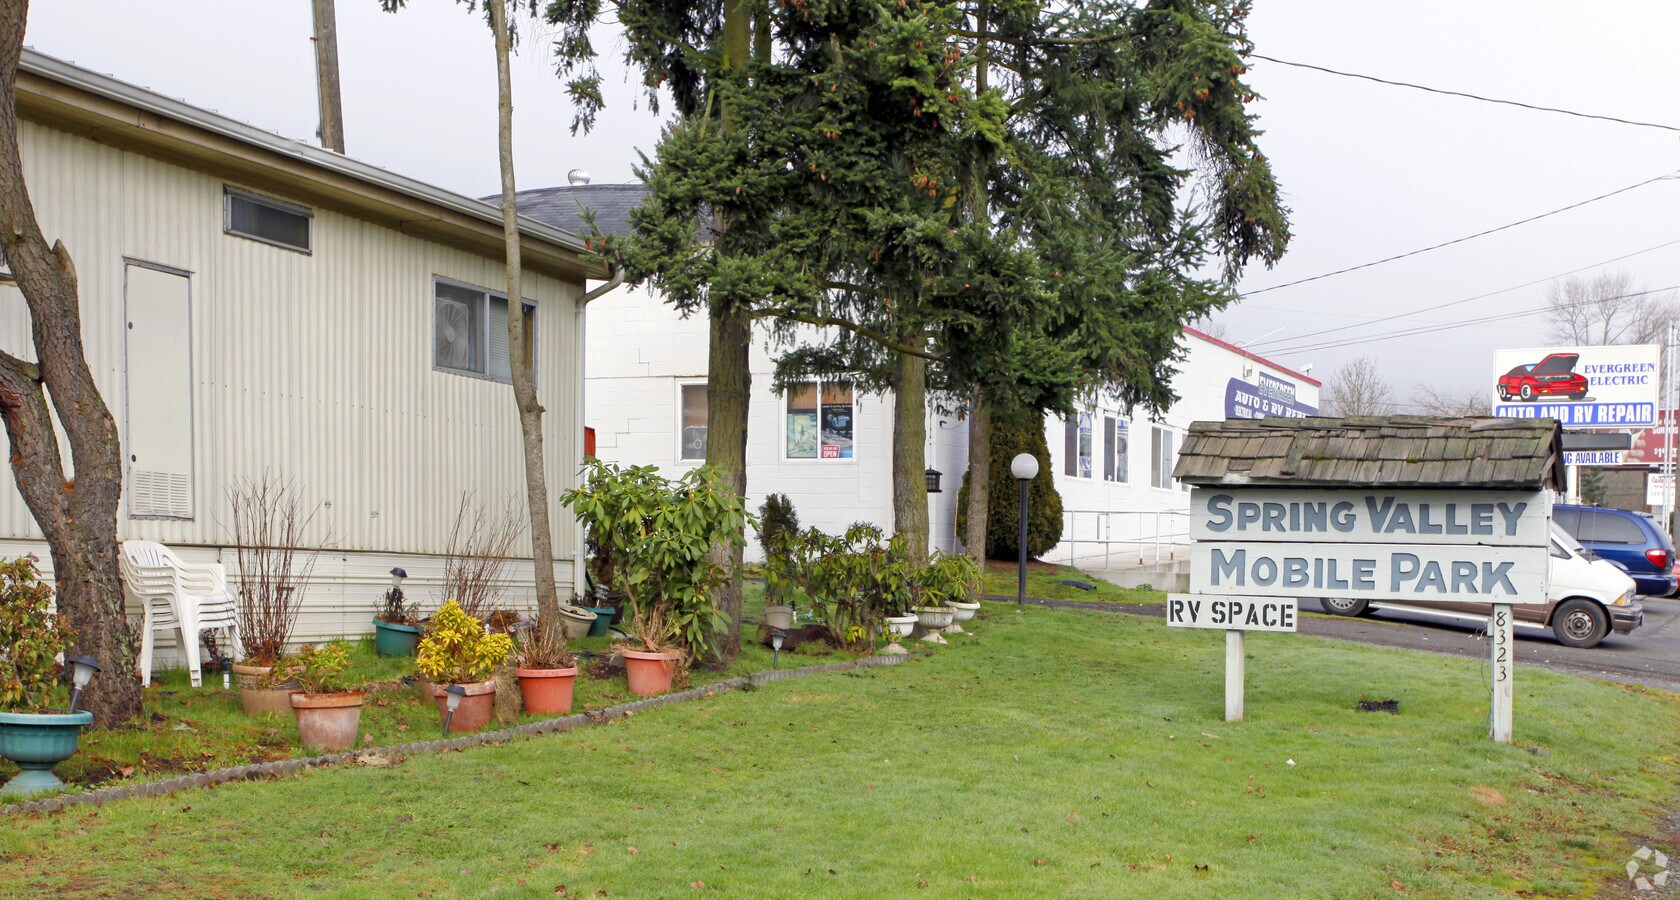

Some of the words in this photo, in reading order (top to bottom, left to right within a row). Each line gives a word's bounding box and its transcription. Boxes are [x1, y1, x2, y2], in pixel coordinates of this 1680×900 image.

[1584, 363, 1655, 374] EVERGREEN
[1590, 375, 1649, 386] ELECTRIC
[1235, 391, 1260, 408] AUTO
[1262, 400, 1269, 411] &
[1271, 402, 1284, 416] RV
[1498, 406, 1535, 418] AUTO
[1540, 405, 1569, 423] AND
[1574, 405, 1593, 423] RV
[1597, 404, 1652, 423] REPAIR
[1575, 452, 1620, 464] AVAILABLE
[1206, 494, 1357, 533] SPRING
[1365, 496, 1528, 537] VALLEY
[1210, 548, 1377, 592] MOBILE
[1390, 552, 1518, 596] PARK
[1169, 600, 1201, 624] RV
[1211, 601, 1294, 628] SPACE
[1496, 611, 1508, 682] 8323
